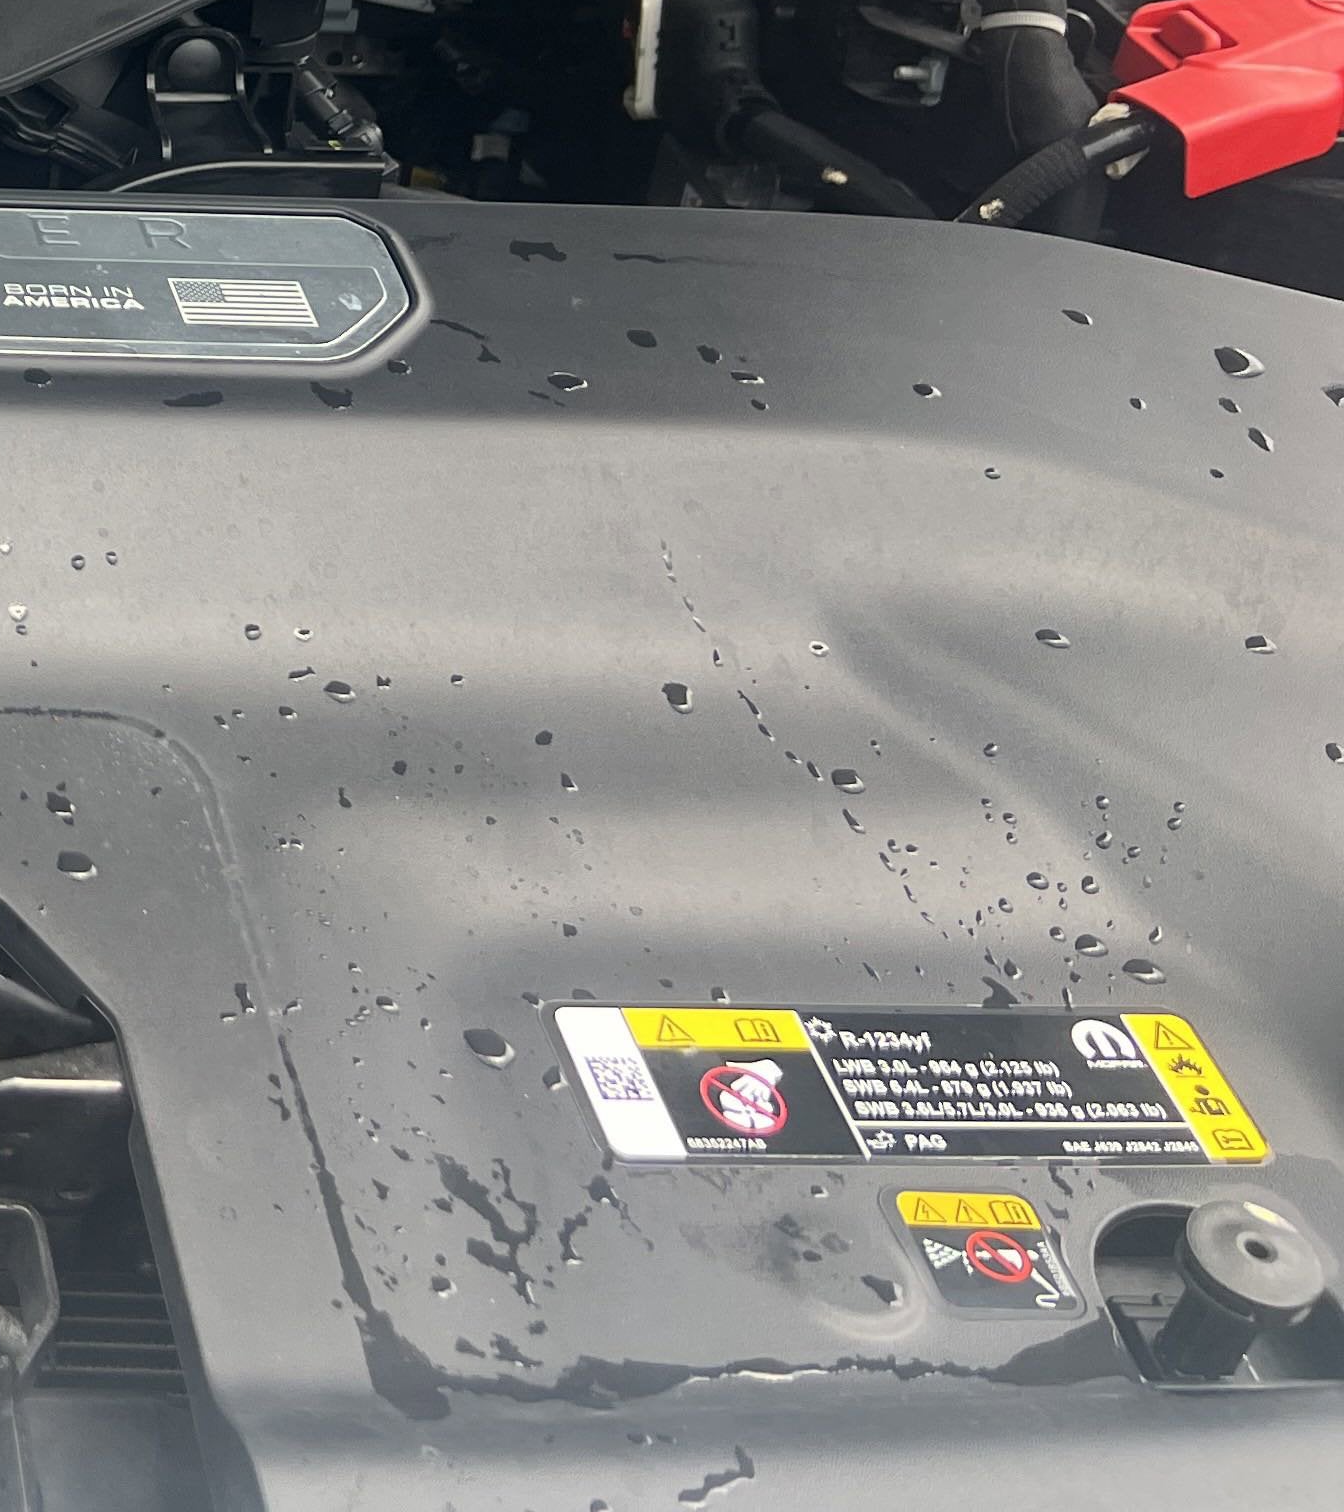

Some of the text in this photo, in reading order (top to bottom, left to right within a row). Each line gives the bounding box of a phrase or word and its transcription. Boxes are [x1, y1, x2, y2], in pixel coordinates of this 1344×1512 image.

[3, 282, 134, 298] BORN IN
[2, 294, 146, 311] AMERICA
[838, 1030, 932, 1055] R-1234yf
[832, 1058, 877, 1076] LWB
[877, 1058, 919, 1076] 3.0L
[964, 1062, 979, 1080] g
[979, 1059, 1033, 1078] (2.125
[1033, 1059, 1060, 1079] lb)
[842, 1078, 888, 1097] SWB
[889, 1079, 930, 1097] 6.4L
[976, 1082, 992, 1099] g
[992, 1079, 1042, 1098] (1.937
[1045, 1079, 1073, 1100] lb)
[853, 1100, 900, 1119] SWB
[1070, 1104, 1086, 1121] g
[1139, 1101, 1168, 1121] lb)
[903, 1133, 948, 1152] PAG
[1062, 1140, 1092, 1153] SAE
